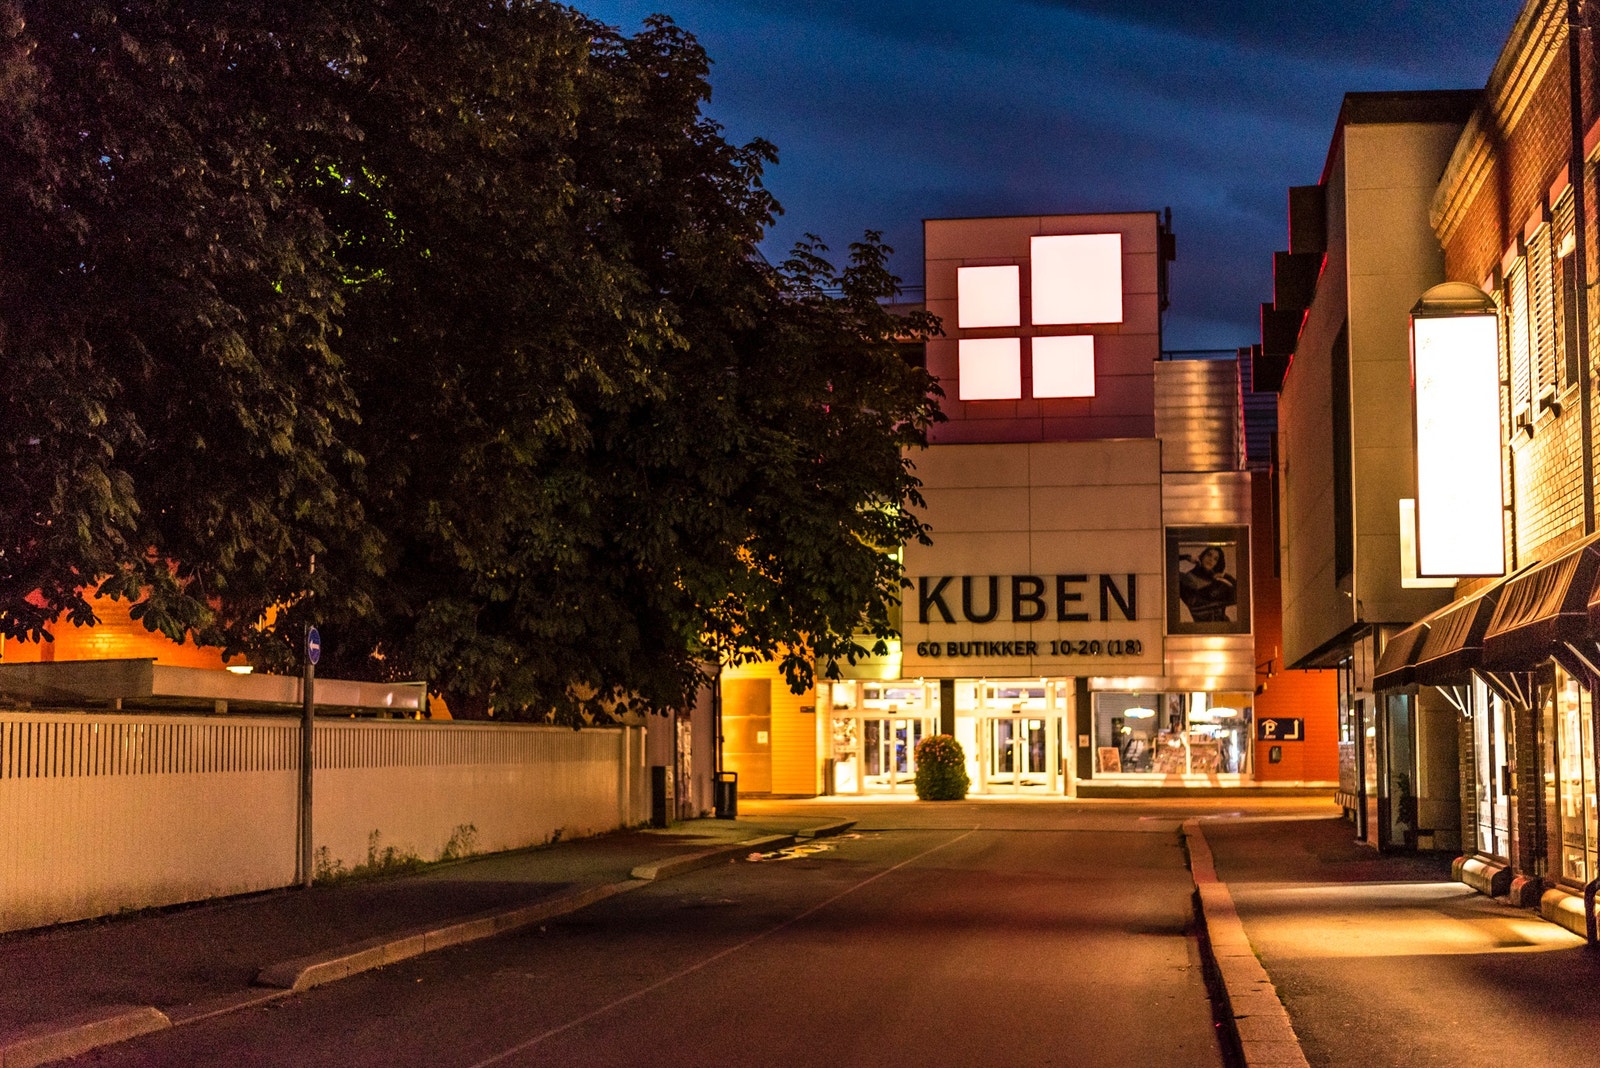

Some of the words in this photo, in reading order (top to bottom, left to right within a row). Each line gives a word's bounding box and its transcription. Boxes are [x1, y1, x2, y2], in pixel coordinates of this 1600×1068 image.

[918, 573, 1137, 624] KUBEN
[917, 641, 941, 657] 60
[947, 640, 1037, 657] BUTIKKER
[1050, 640, 1100, 656] 10-20
[1107, 639, 1142, 656] (18)
[1265, 722, 1276, 736] P
